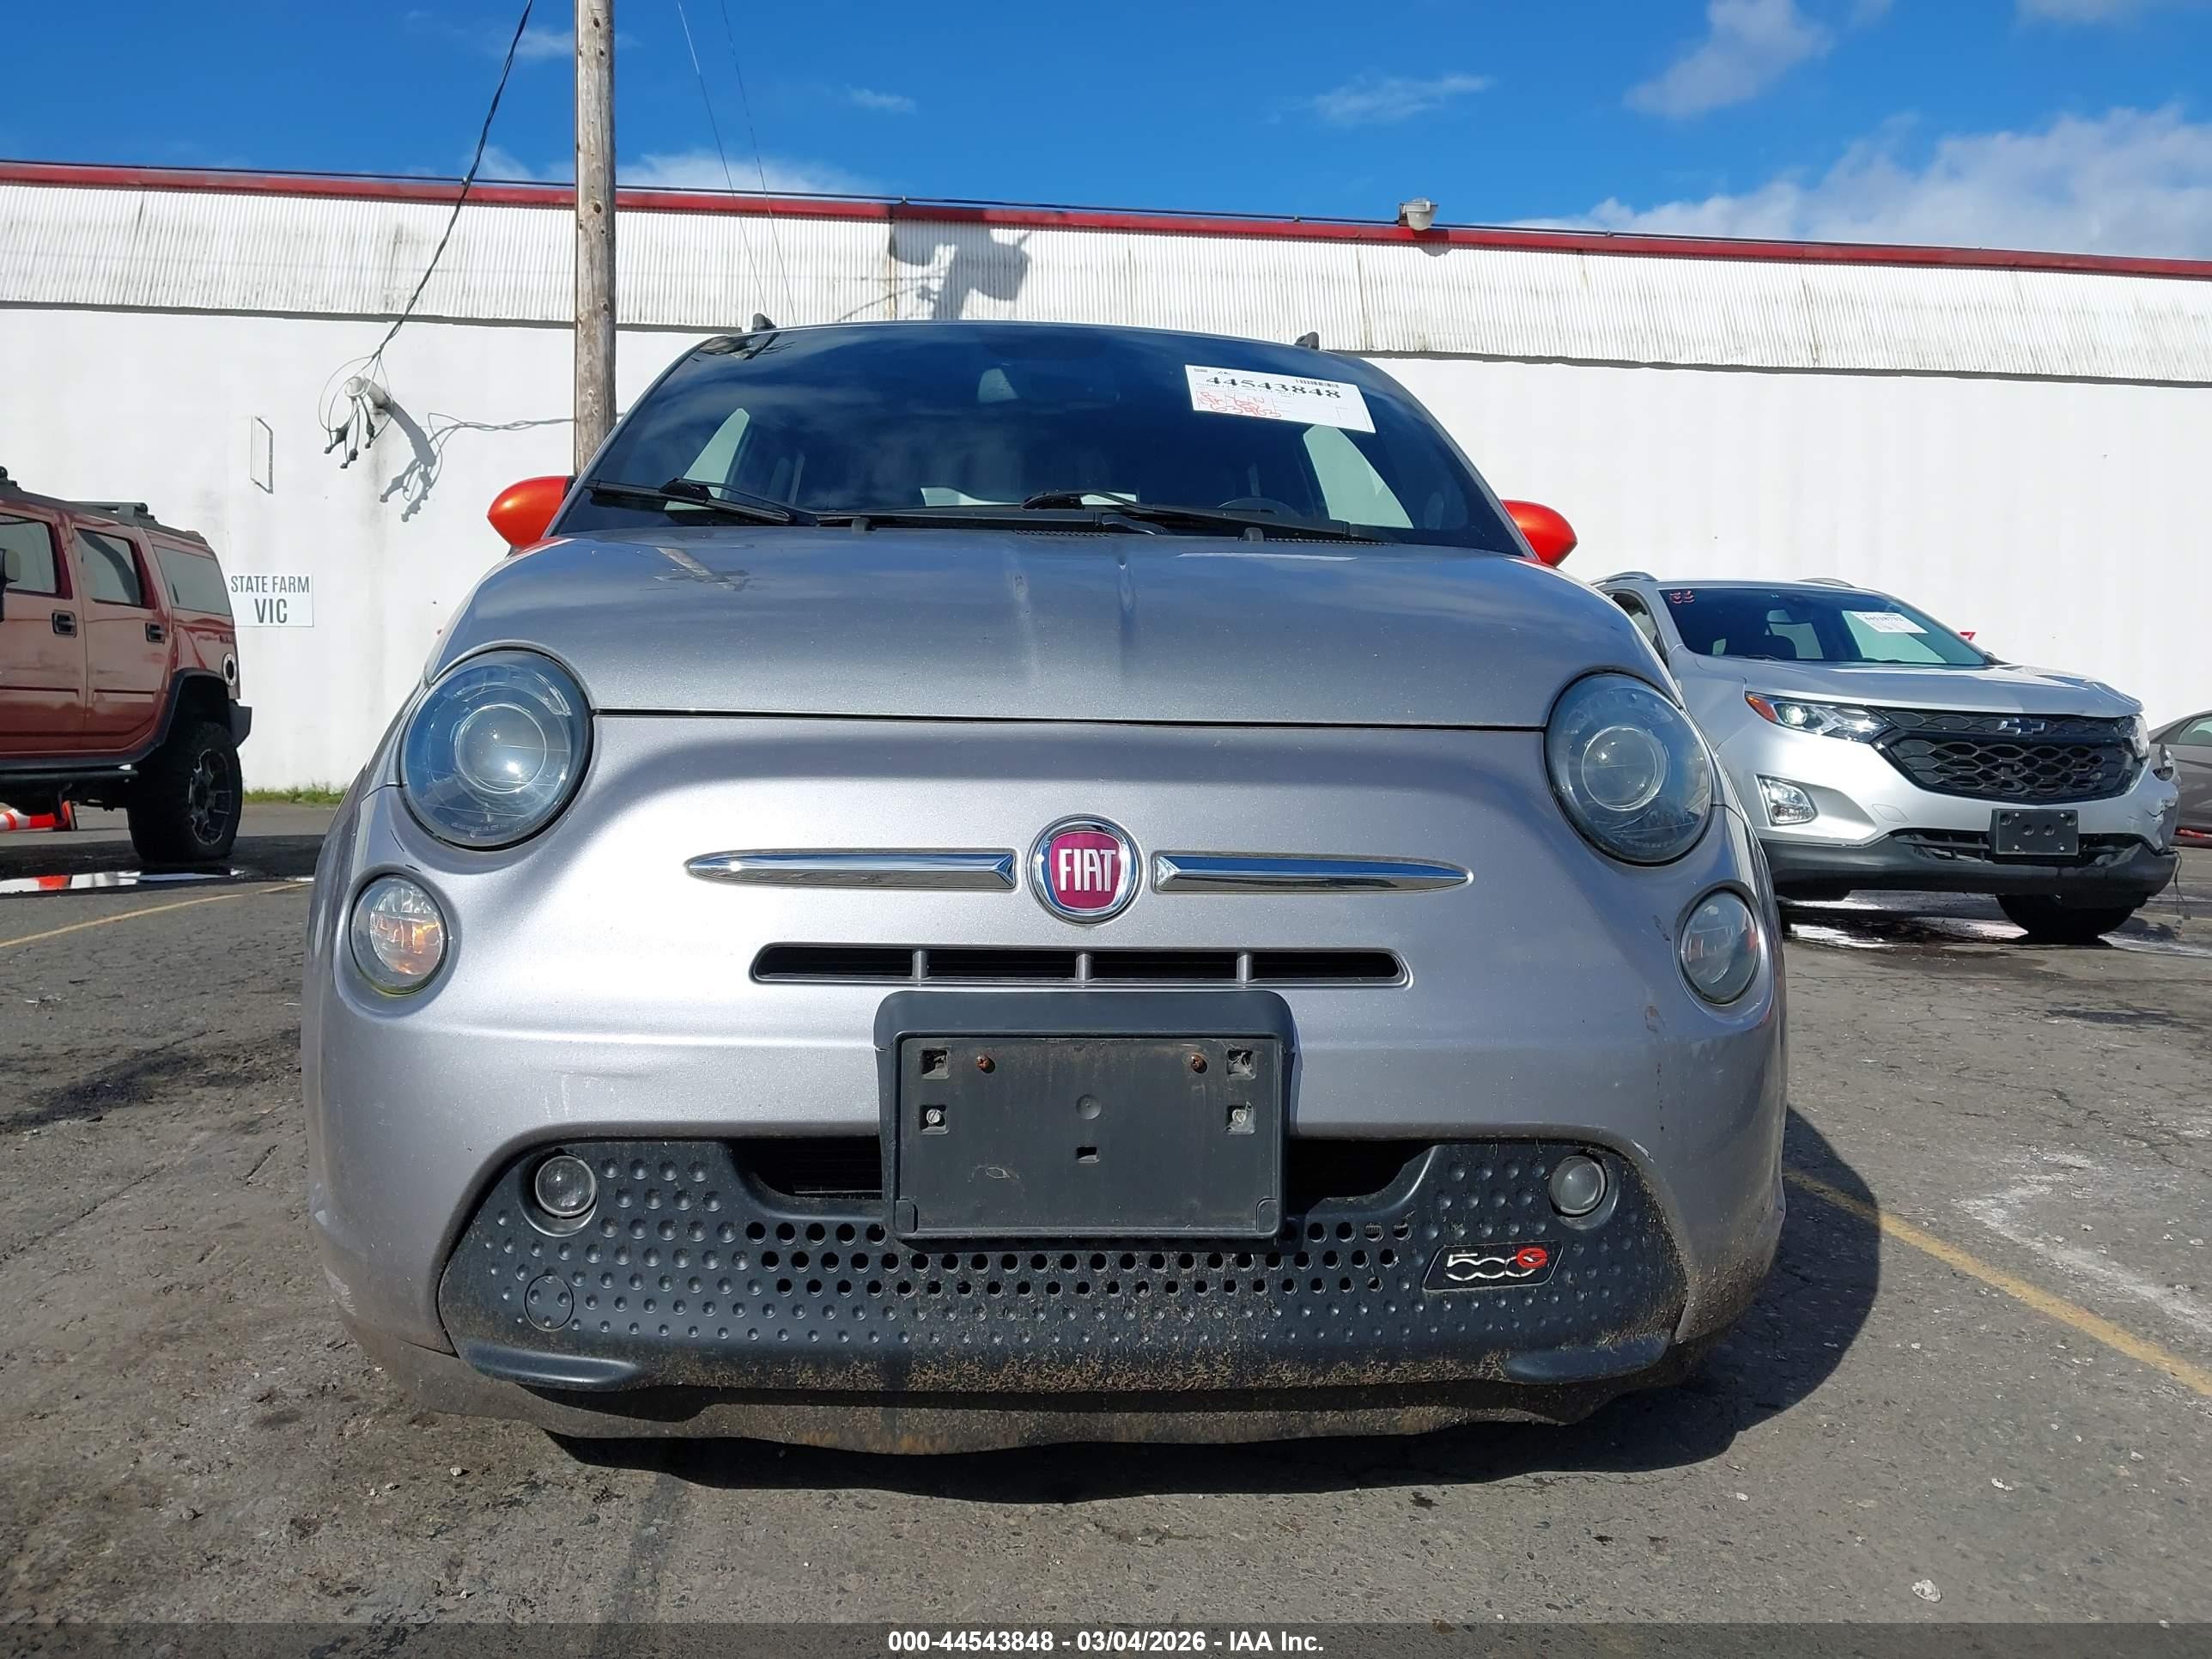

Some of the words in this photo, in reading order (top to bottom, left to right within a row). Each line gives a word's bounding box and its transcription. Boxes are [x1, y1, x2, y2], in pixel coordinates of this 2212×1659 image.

[1207, 376, 1341, 398] 44543848
[231, 575, 268, 592] STATE
[272, 575, 309, 592] FARM
[254, 599, 287, 623] VIC
[1059, 848, 1116, 892] FIAT
